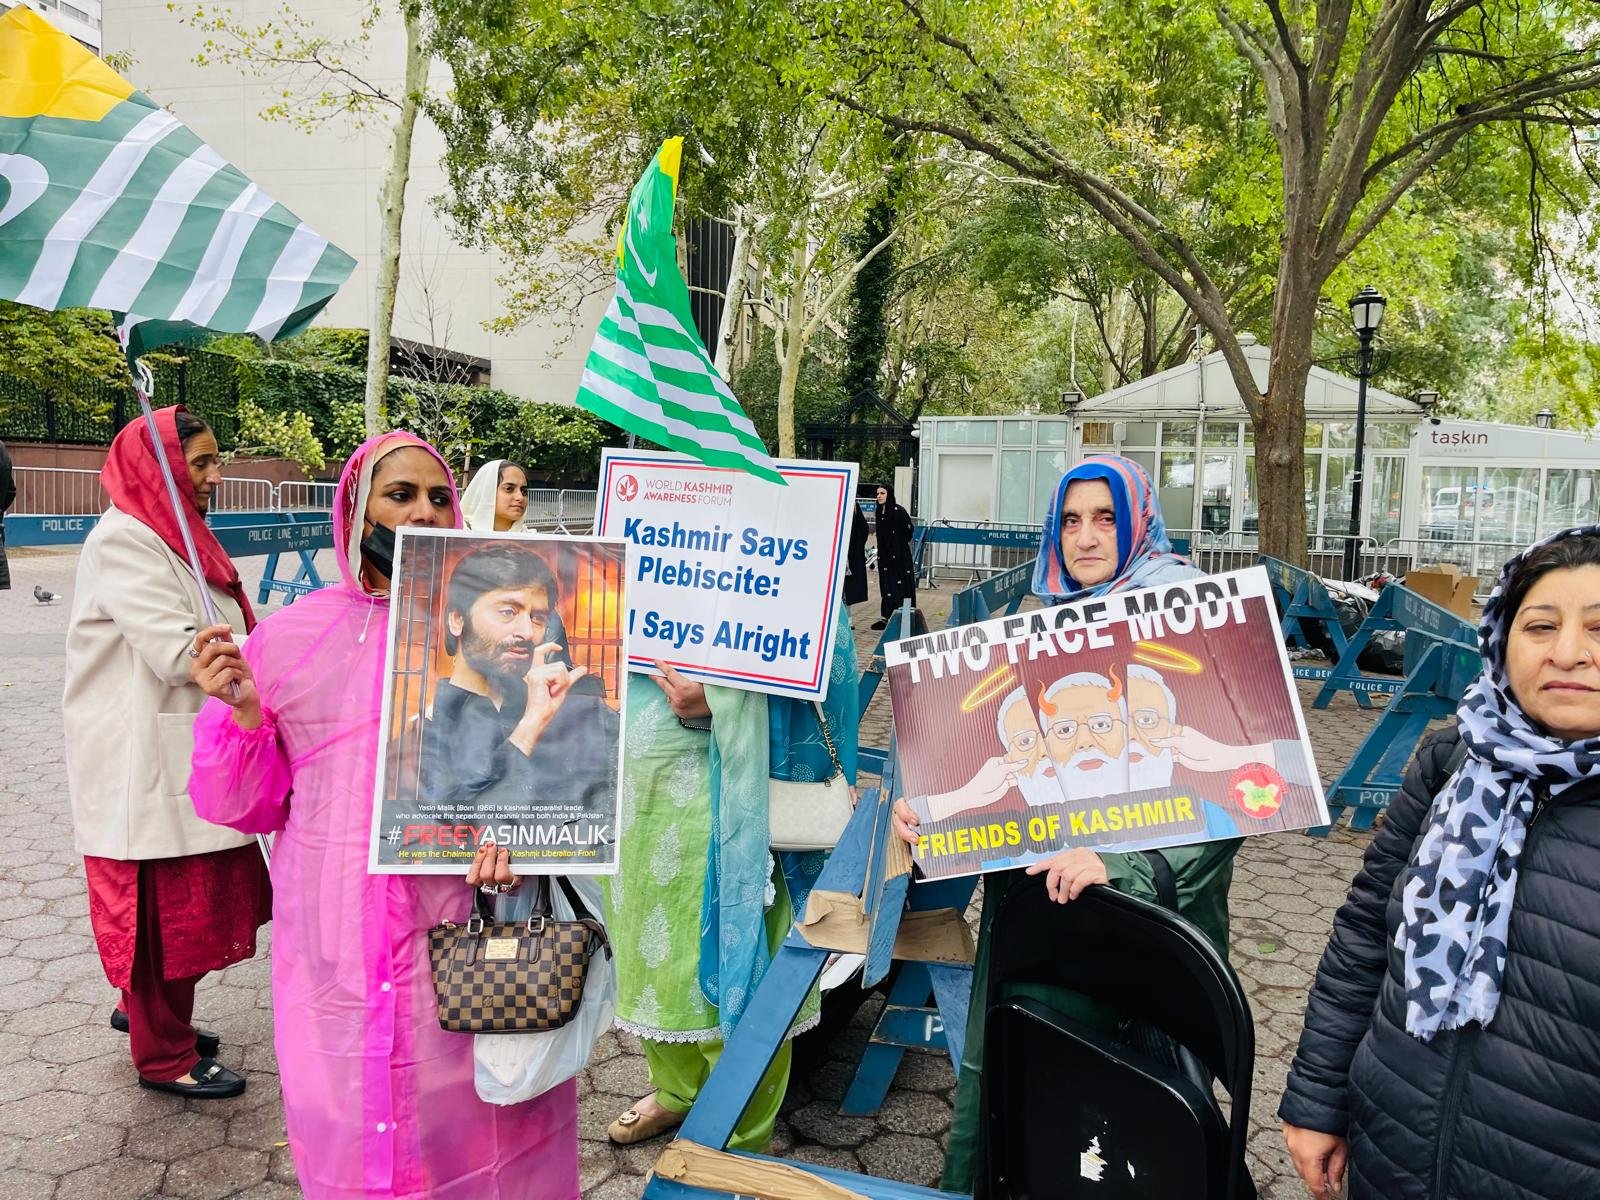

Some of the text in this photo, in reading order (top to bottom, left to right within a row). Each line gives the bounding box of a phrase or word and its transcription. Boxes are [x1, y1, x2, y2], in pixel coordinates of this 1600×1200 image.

[1431, 430, 1488, 446] taşkın
[645, 479, 733, 495] WORLD KASHMIR
[643, 491, 732, 507] AWARENESS FORUM
[42, 519, 84, 531] POLICE
[248, 528, 273, 541] POLICE
[277, 527, 292, 540] LINE
[311, 525, 324, 537] NOT
[623, 517, 809, 566] Kashmir Says
[637, 555, 781, 598] Plebiscite:
[642, 611, 705, 650] Says
[712, 620, 811, 663] Alright
[900, 625, 991, 684] TWO
[1002, 601, 1115, 665] FACE
[1123, 577, 1248, 642] MODI
[1350, 681, 1382, 692] POLICE
[576, 812, 604, 820] Pakistan
[387, 824, 609, 846] #FREEYASINMALIK
[917, 796, 1197, 860] FRIENDS OF KASHMIR
[398, 850, 409, 858] He
[411, 850, 427, 858] was
[429, 850, 440, 858] the
[441, 850, 476, 858] Chairman
[512, 850, 540, 858] Kashmir
[541, 850, 576, 858] Liberation
[577, 850, 596, 858] Front
